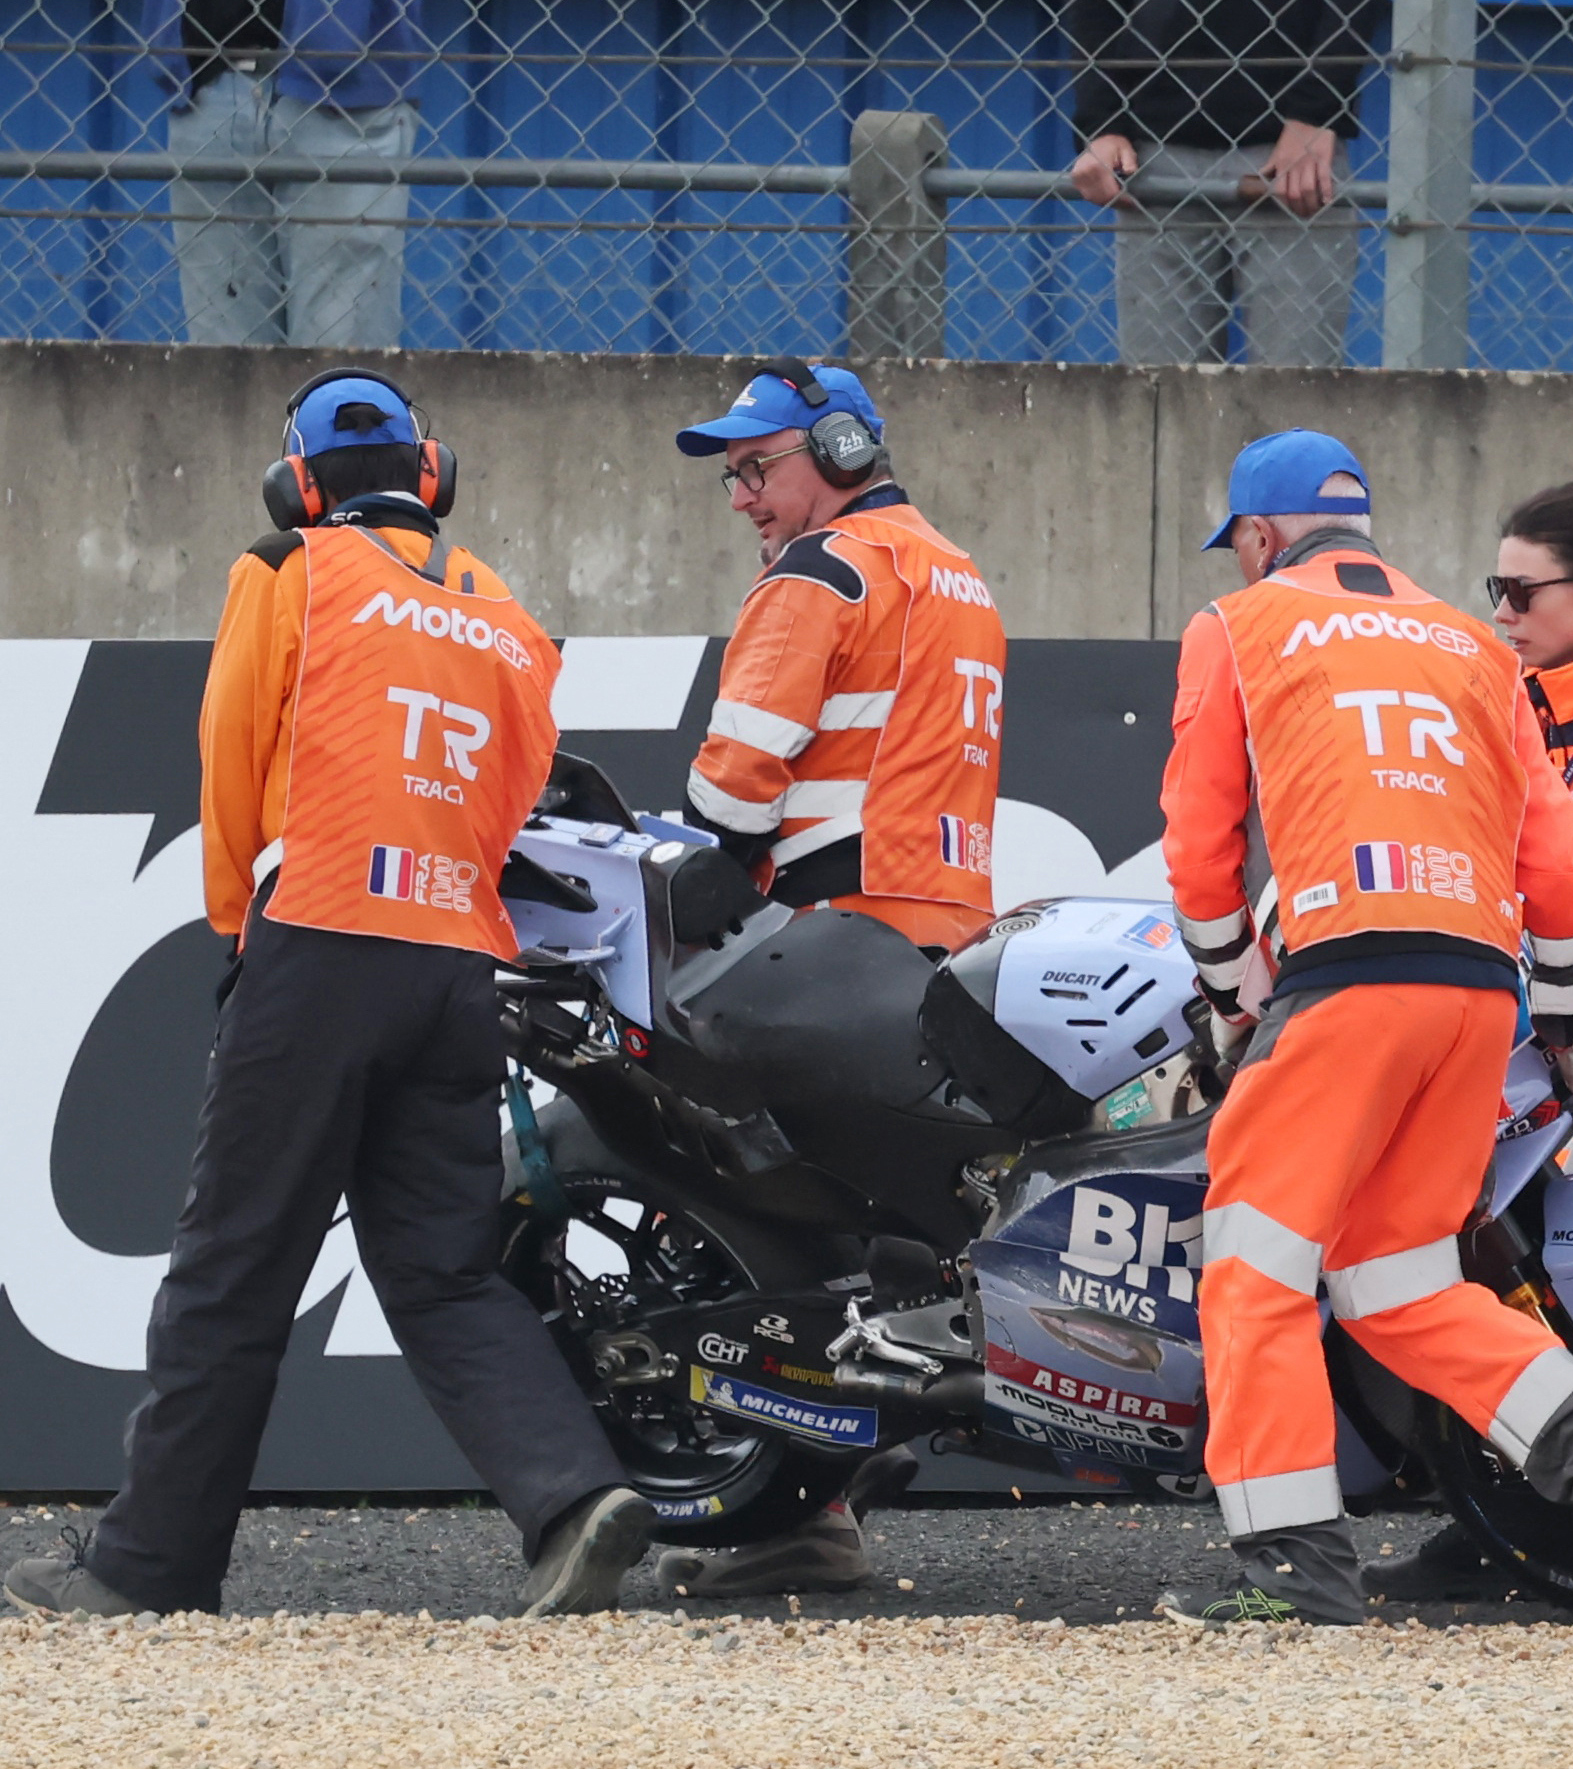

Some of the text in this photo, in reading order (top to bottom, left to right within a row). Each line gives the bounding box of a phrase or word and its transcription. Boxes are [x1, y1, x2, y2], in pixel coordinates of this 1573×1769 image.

[930, 563, 998, 612] Moto
[350, 590, 533, 672] MotoGP
[1280, 609, 1480, 659] MotoGP
[954, 656, 1004, 740] TR
[386, 685, 492, 783] TR
[1331, 689, 1465, 768] TR
[402, 774, 465, 806] TRAC
[1370, 768, 1448, 798] TRACK
[414, 853, 432, 906] FRA
[1409, 844, 1428, 894] FRA
[1041, 970, 1102, 987] DUCATI
[1057, 1270, 1157, 1325] NEWS
[740, 1393, 860, 1434] MICHELIN
[996, 1384, 1142, 1436] MODULA
[1032, 1368, 1168, 1421] ASPIRA
